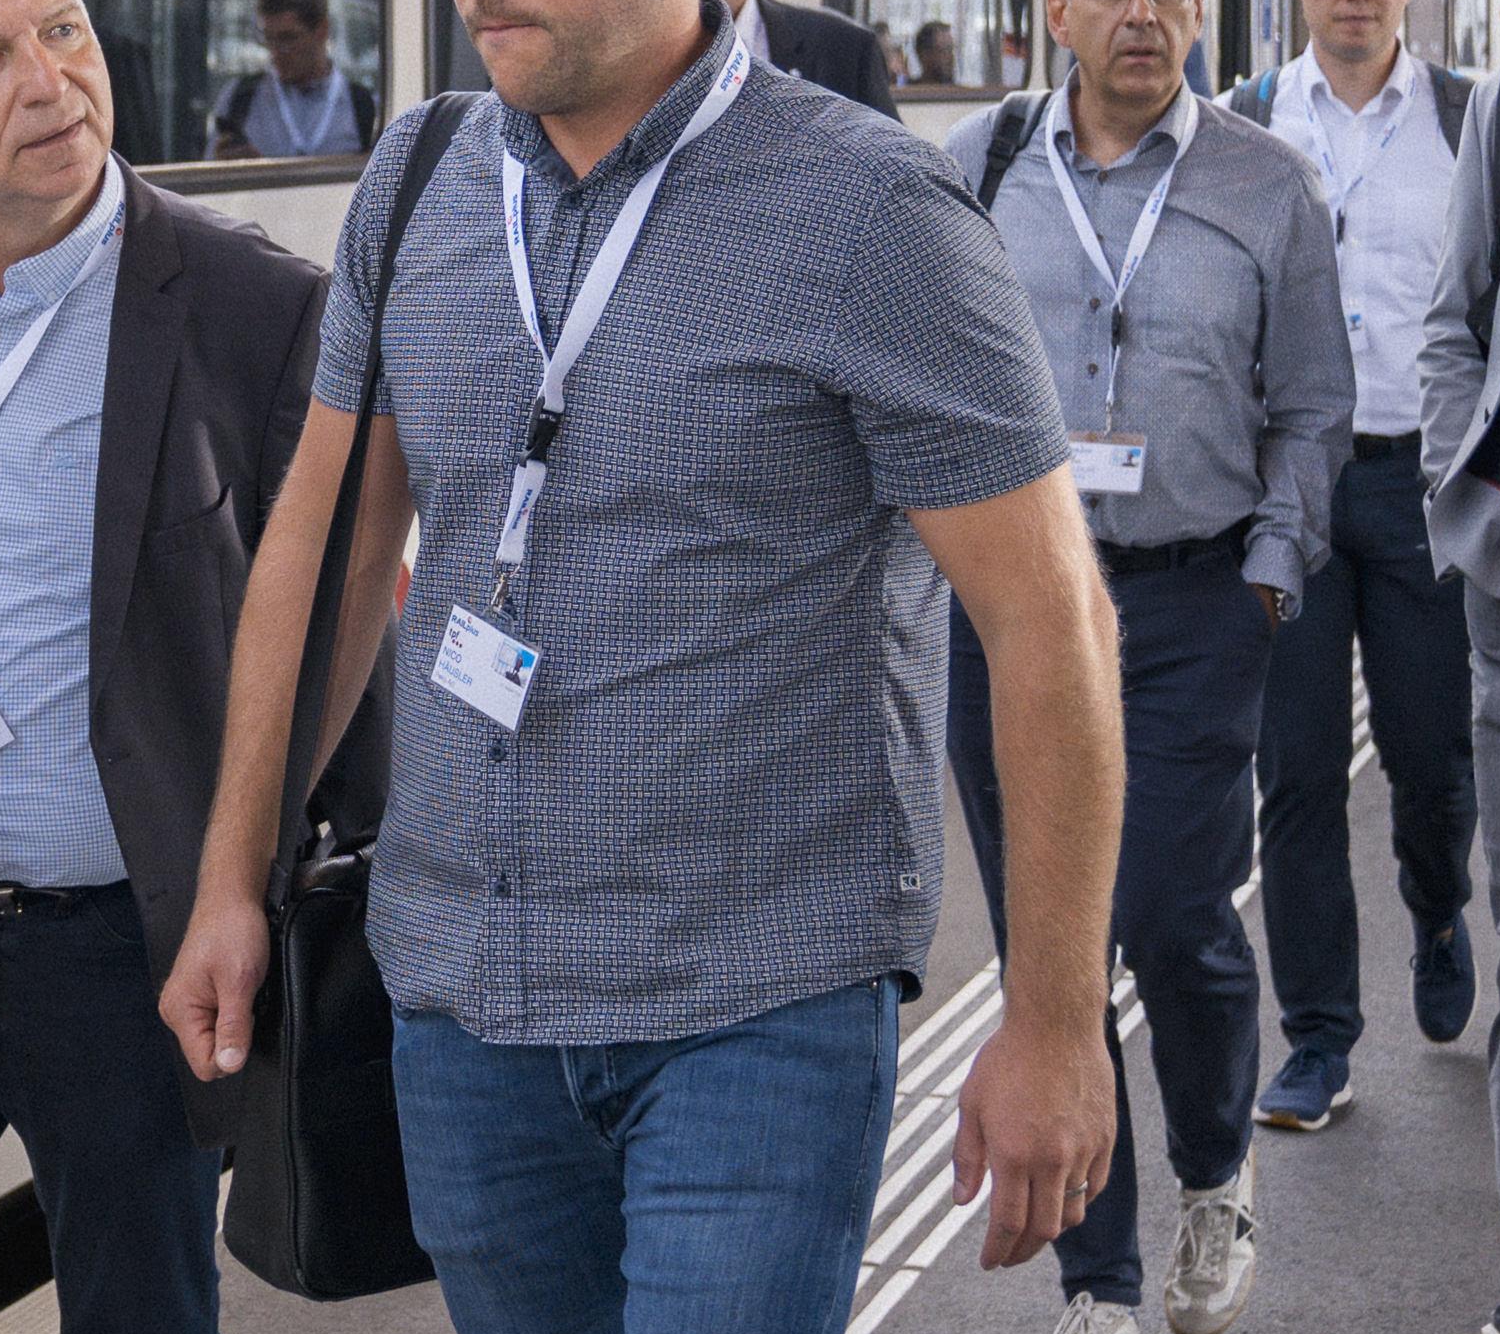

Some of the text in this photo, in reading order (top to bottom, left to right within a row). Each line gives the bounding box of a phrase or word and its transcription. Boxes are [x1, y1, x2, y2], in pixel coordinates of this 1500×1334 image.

[720, 50, 743, 91] RAILplus
[101, 200, 125, 245] RAILplus
[449, 628, 461, 640] tpf
[451, 614, 480, 637] RAILplus
[442, 645, 463, 664] NICO
[438, 659, 474, 686] HÄUSLER
